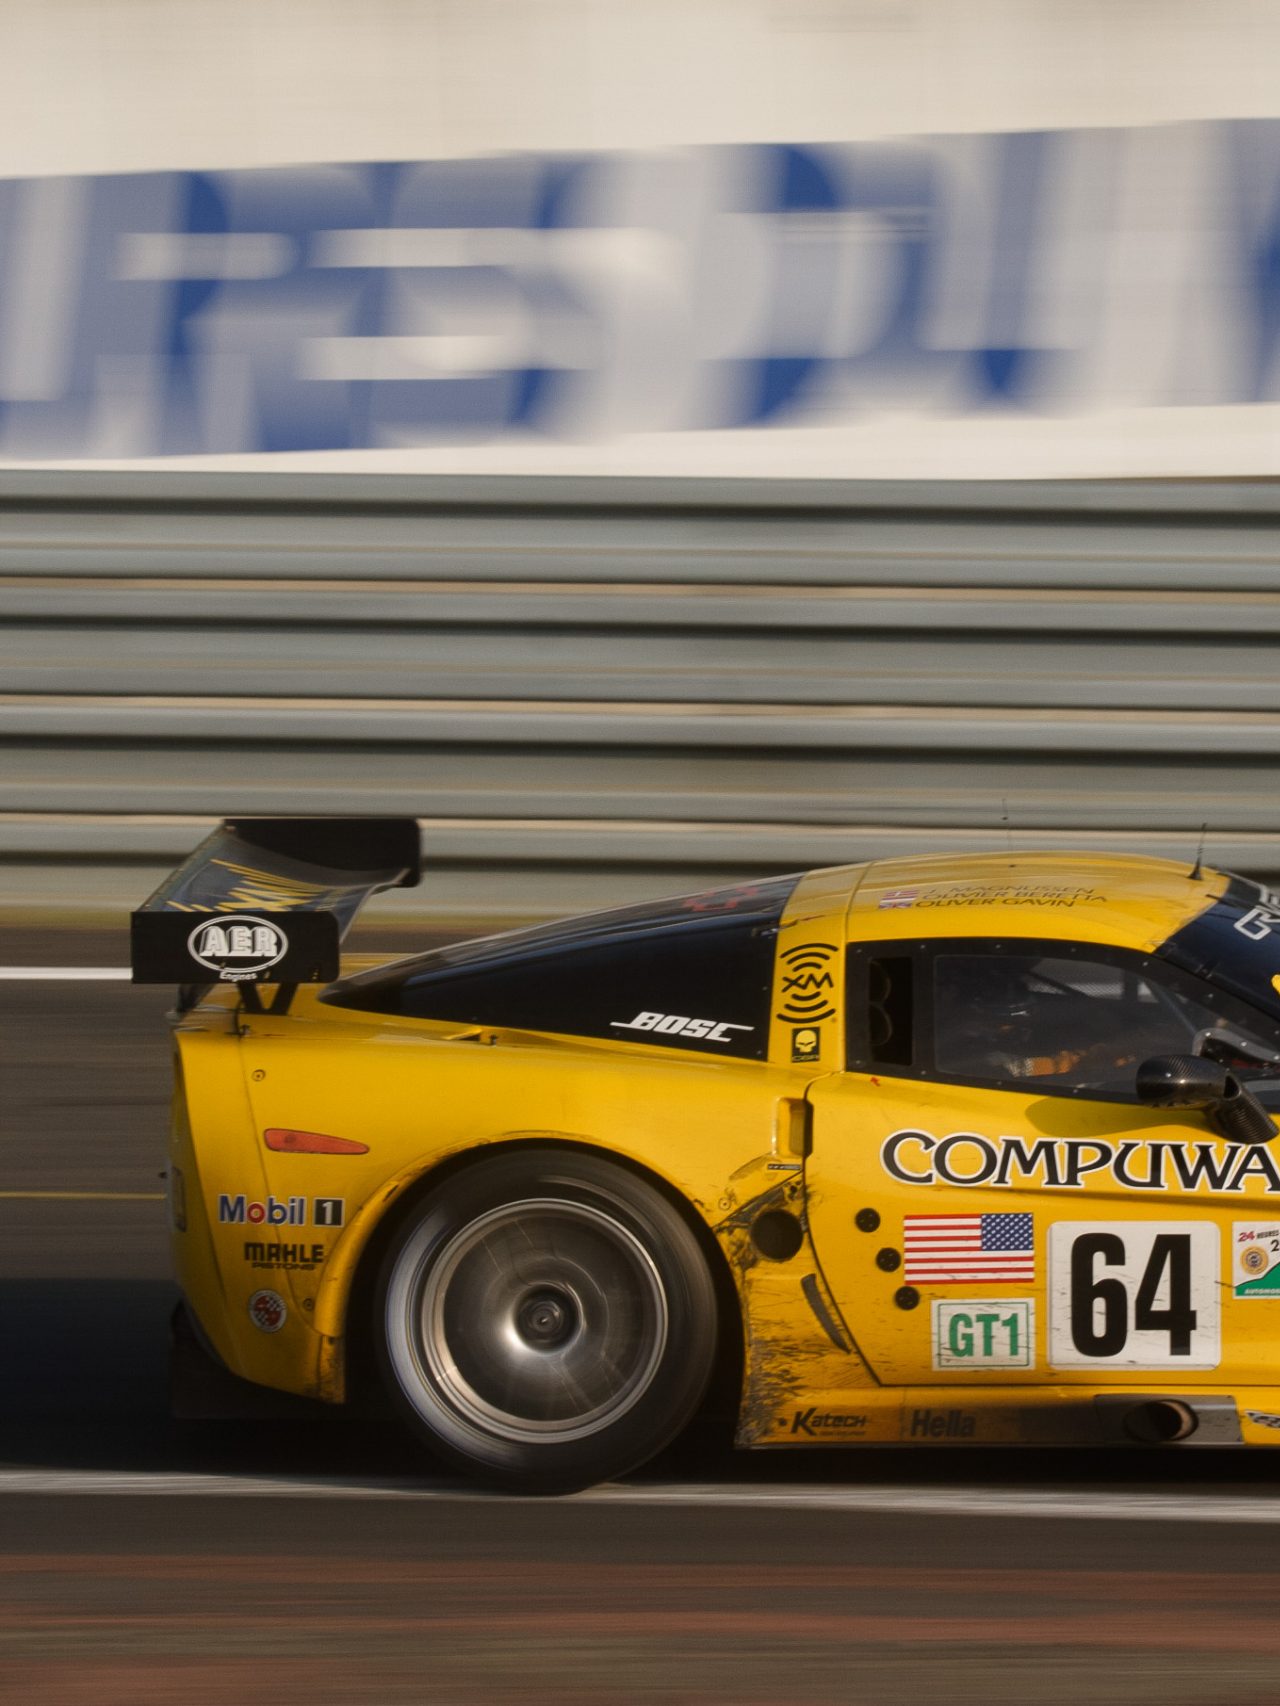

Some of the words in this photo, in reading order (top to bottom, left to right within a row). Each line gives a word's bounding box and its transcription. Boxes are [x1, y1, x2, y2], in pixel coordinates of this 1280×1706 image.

[915, 898, 996, 908] OLIVER
[999, 898, 1076, 908] GAVIN
[199, 925, 278, 957] AER
[609, 1011, 755, 1043] BOSE
[218, 1194, 306, 1226] Mobil
[244, 1242, 325, 1263] MAHLE
[1238, 1231, 1255, 1242] 24
[1071, 1232, 1197, 1357] 64
[948, 1312, 1019, 1358] GT1
[910, 1409, 977, 1437] Hella
